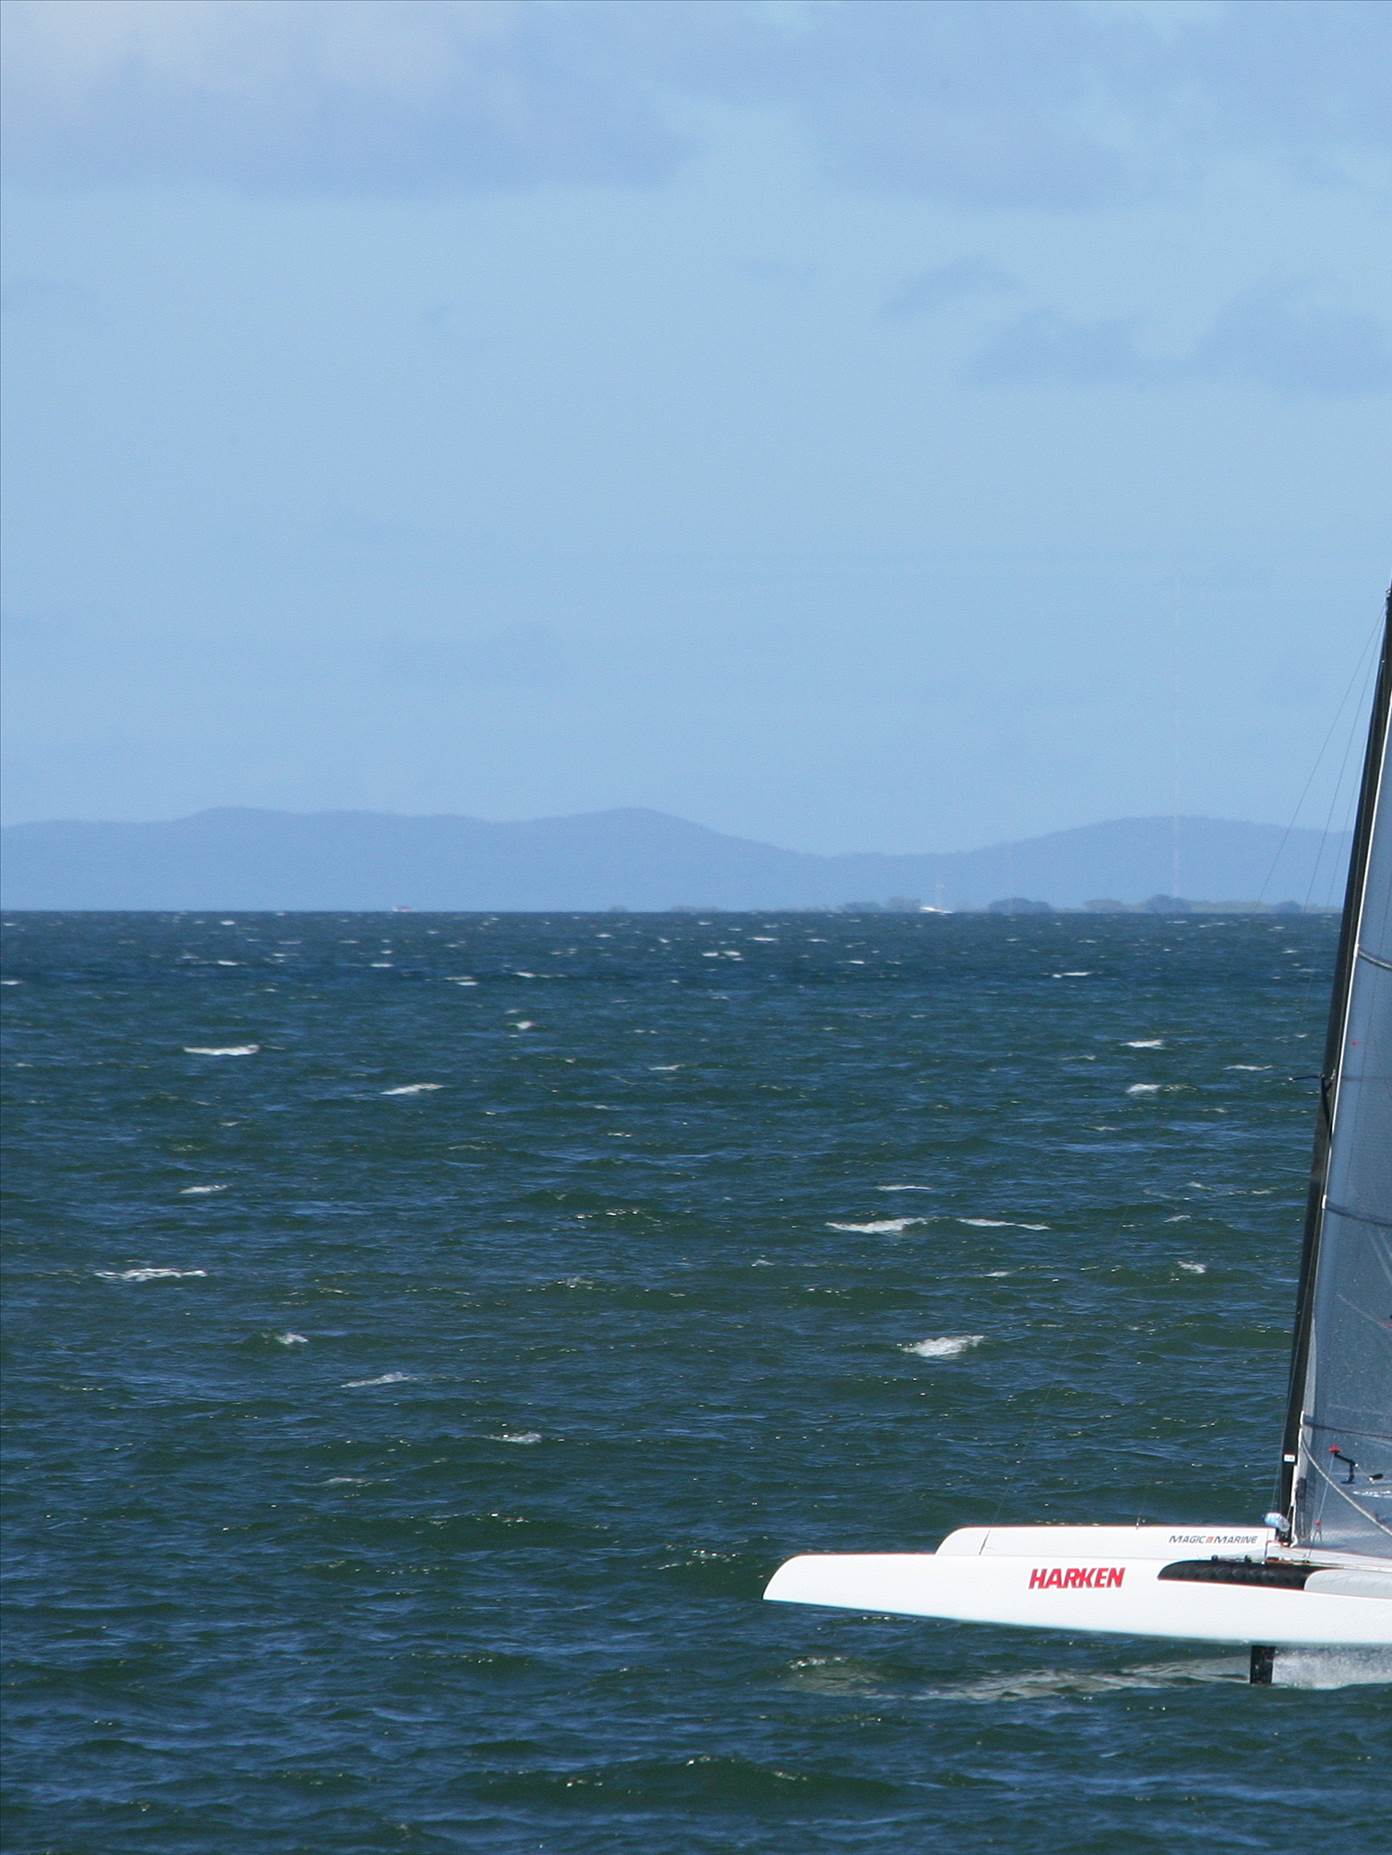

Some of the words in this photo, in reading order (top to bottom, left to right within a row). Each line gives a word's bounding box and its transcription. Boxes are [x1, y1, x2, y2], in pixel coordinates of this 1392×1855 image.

[1168, 1535, 1206, 1544] MAGIC
[1214, 1535, 1258, 1544] MARINE
[1028, 1567, 1126, 1590] HARKEN
